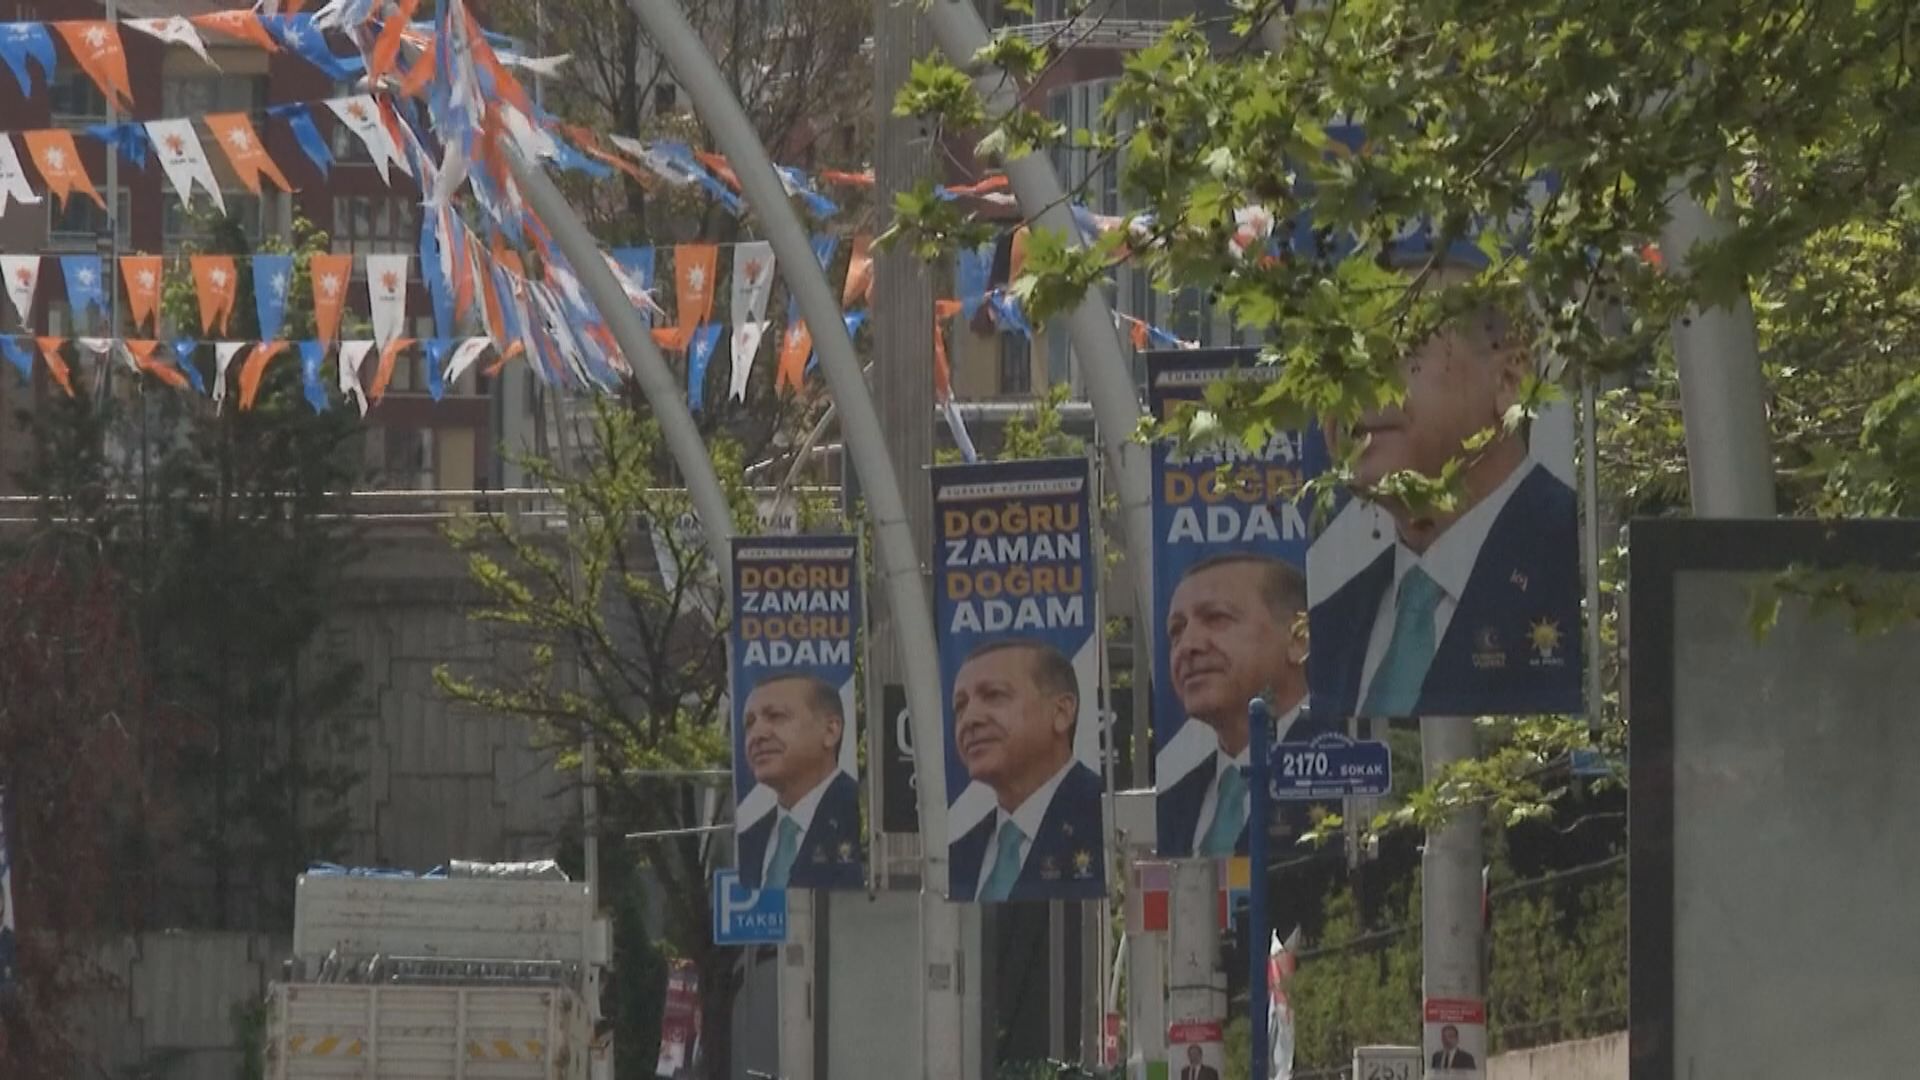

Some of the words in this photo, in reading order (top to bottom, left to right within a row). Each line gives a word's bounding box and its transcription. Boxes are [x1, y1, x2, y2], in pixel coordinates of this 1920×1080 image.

[1164, 464, 1303, 504] DOĞR
[944, 501, 1079, 538] DOĞRU
[945, 534, 1081, 566] ZAMAN
[741, 562, 849, 590] DOĞRU
[947, 563, 1082, 600] DOĞRU
[742, 590, 850, 612] ZAMAN
[950, 596, 1084, 634] ADAM
[741, 614, 850, 640] DOĞRU
[743, 640, 850, 667] ADAM
[1340, 764, 1383, 777] SOKAK
[721, 874, 761, 935] P
